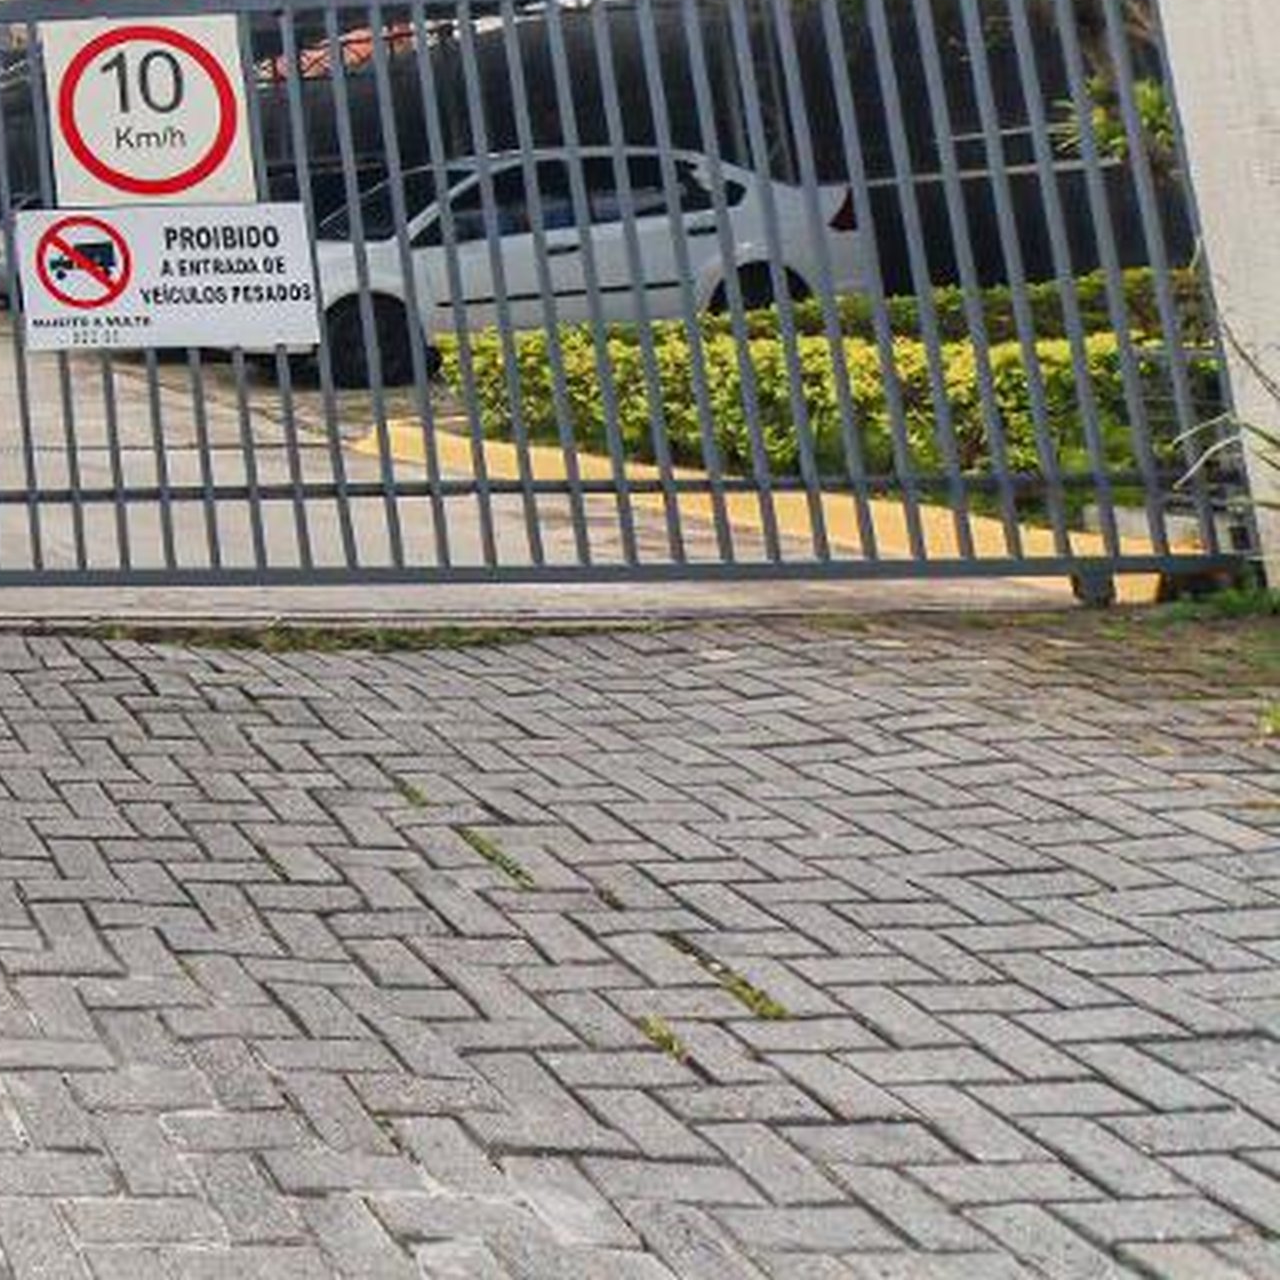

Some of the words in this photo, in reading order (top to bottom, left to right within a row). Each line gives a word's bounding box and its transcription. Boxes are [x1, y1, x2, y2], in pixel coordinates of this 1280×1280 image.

[101, 49, 183, 114] 10
[115, 126, 186, 150] Km/h
[164, 225, 280, 250] PROIBIDO
[160, 260, 173, 276] A
[177, 258, 259, 276] ENTRADA
[263, 256, 286, 274] DE
[140, 283, 227, 304] VEÍCULOS
[232, 282, 312, 303] PESADOS
